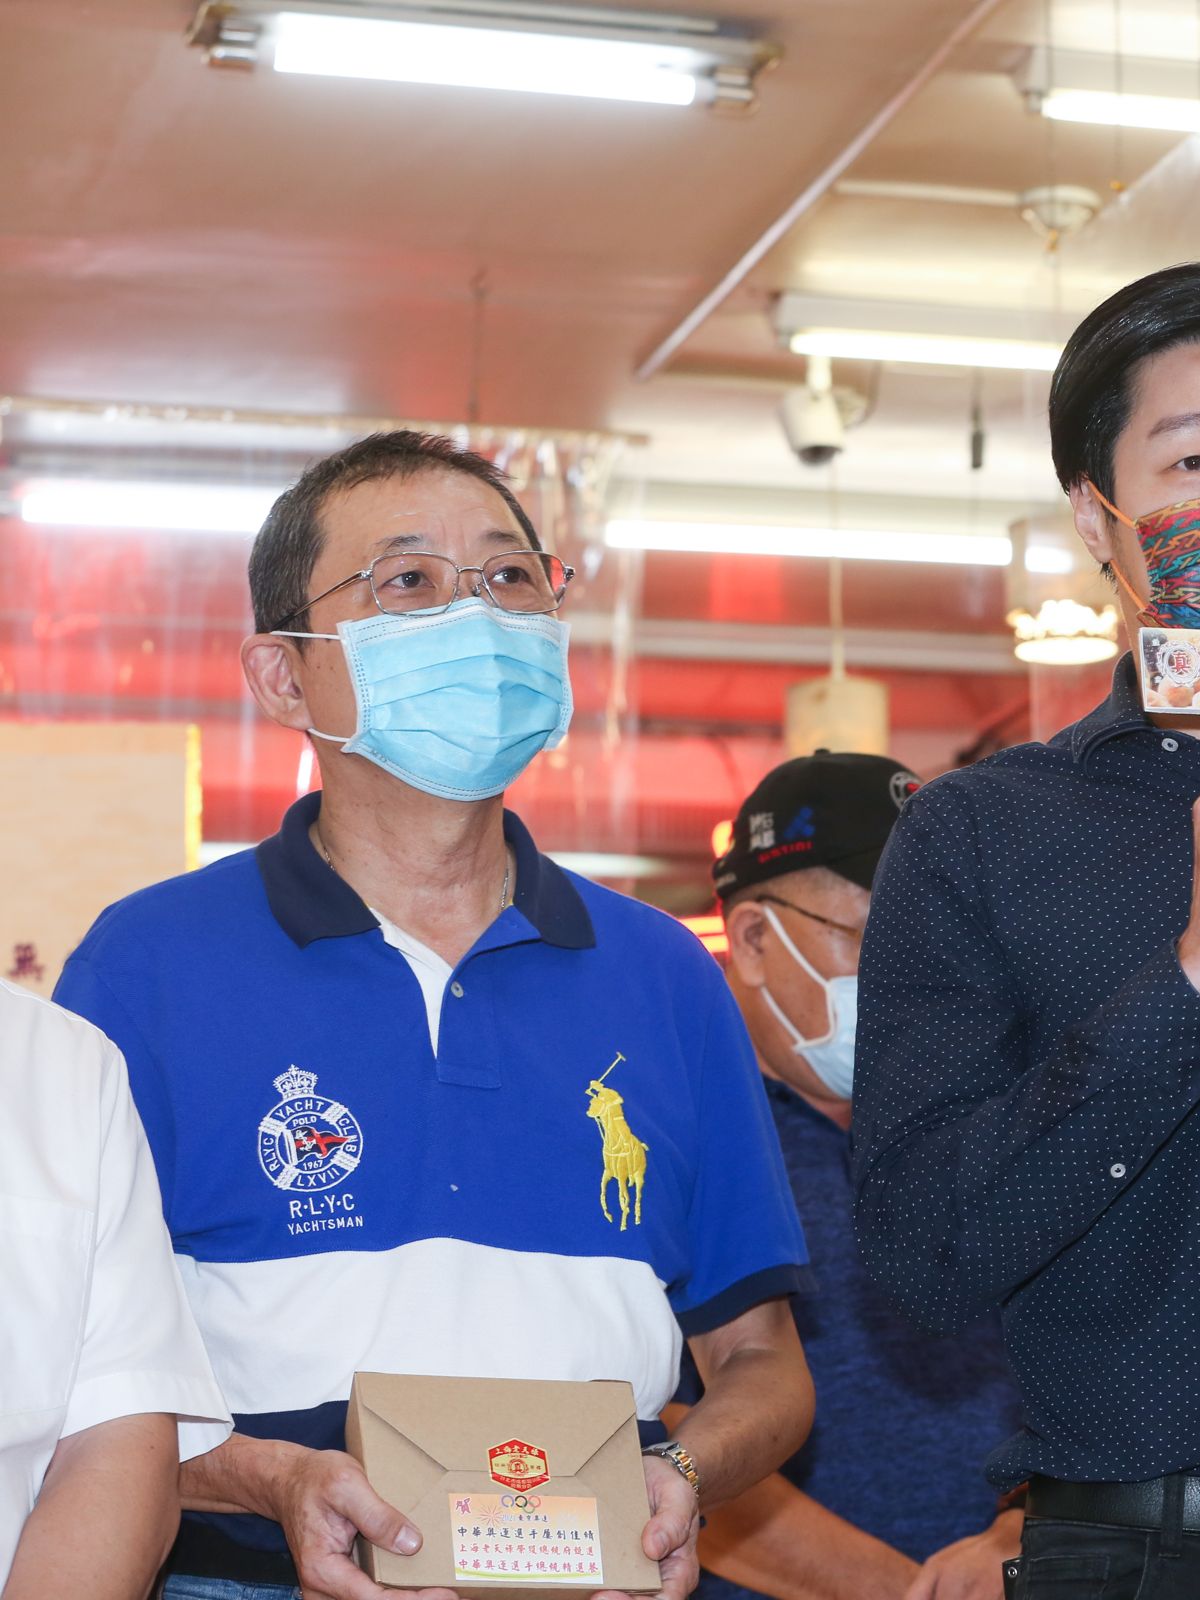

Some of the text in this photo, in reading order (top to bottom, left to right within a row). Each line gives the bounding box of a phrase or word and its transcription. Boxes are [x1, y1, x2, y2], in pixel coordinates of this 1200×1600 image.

[275, 1099, 325, 1119] YACHT
[292, 1115, 317, 1127] POLO
[262, 1137, 281, 1172] RLYC
[303, 1159, 324, 1171] 1967
[297, 1167, 340, 1188] LXVII
[287, 1215, 364, 1236] YACHTSMAN
